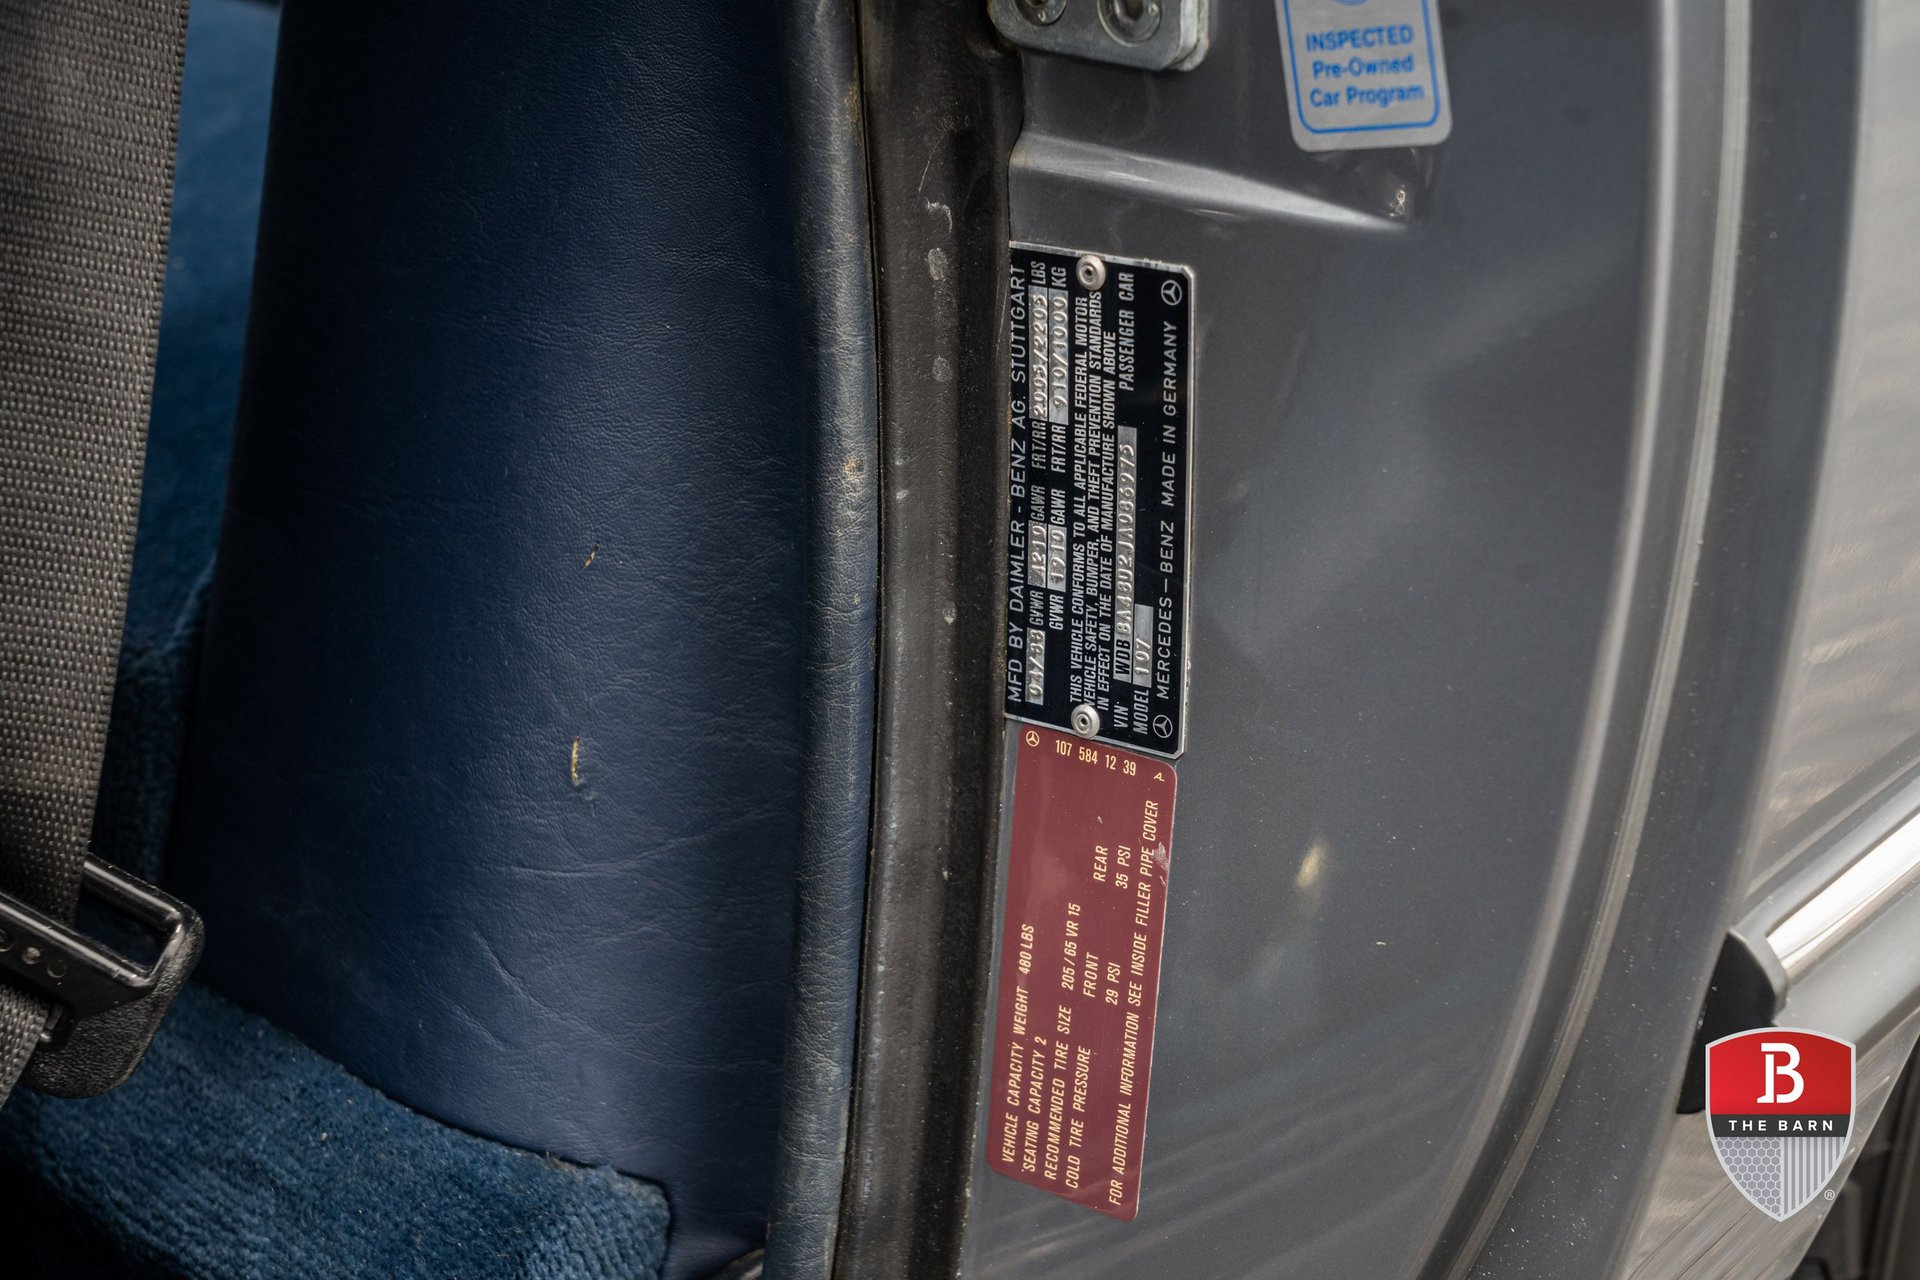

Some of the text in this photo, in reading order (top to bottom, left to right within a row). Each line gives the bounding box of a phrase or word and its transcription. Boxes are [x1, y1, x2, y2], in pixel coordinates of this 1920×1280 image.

[1306, 24, 1414, 51] INSPECTED
[1312, 54, 1414, 79] Pre-Owned
[1309, 85, 1425, 108] Car Program
[1031, 261, 1045, 284] LBS
[1010, 265, 1025, 383] STUTTGART
[1119, 272, 1134, 390] PASSENGER CAR
[1164, 321, 1176, 416] GERMANY
[1011, 396, 1026, 429] AG.
[1163, 424, 1175, 444] IN
[1032, 420, 1046, 469] FRT/RR
[1050, 267, 1067, 630] GVWR 1910 GAWR FRT/RR 910/1000 KG
[1070, 297, 1087, 702] THIS VEHICLE CONFORMS TO ALL APPLICABLE FEDERAL MOTOR
[1085, 291, 1101, 705] VEHICLE SAFETY, BUMPER, AND THEFT PREVENTION STANDARDS
[1162, 452, 1175, 506] MADE
[1030, 485, 1045, 521] GAWR
[1098, 331, 1116, 710] IN EFFECT ON THE DATE OF MANUFACTURE SHOWN ABOVE
[1029, 591, 1044, 625] GVWR
[1009, 621, 1023, 648] BY
[1008, 659, 1022, 702] MFD
[1134, 637, 1151, 735] MODEL 107
[1114, 706, 1128, 728] VIN
[1056, 740, 1137, 776] 107 584 12 39
[1094, 845, 1108, 882] REAR
[1116, 845, 1131, 888] 35 PSI
[1066, 920, 1078, 937] VR
[1068, 903, 1081, 916] 15
[1084, 951, 1099, 997] FRONT
[1105, 962, 1121, 1005] 29 PSI
[1059, 1005, 1072, 1034] SIZE
[1109, 800, 1158, 1205] FOR ADDITIONAL INFORMATION SEE INSIDE FILLER PIPE COVER
[1002, 924, 1034, 1162] VEHICLE CAPACITY WEIGHT 480 LBS
[1054, 1041, 1069, 1070] TIRE
[1023, 1035, 1047, 1172] SEATING CAPACITY 2
[1066, 1046, 1091, 1188] COLD TIRE PRESSURE
[1045, 1078, 1065, 1180] RECOMMENDED
